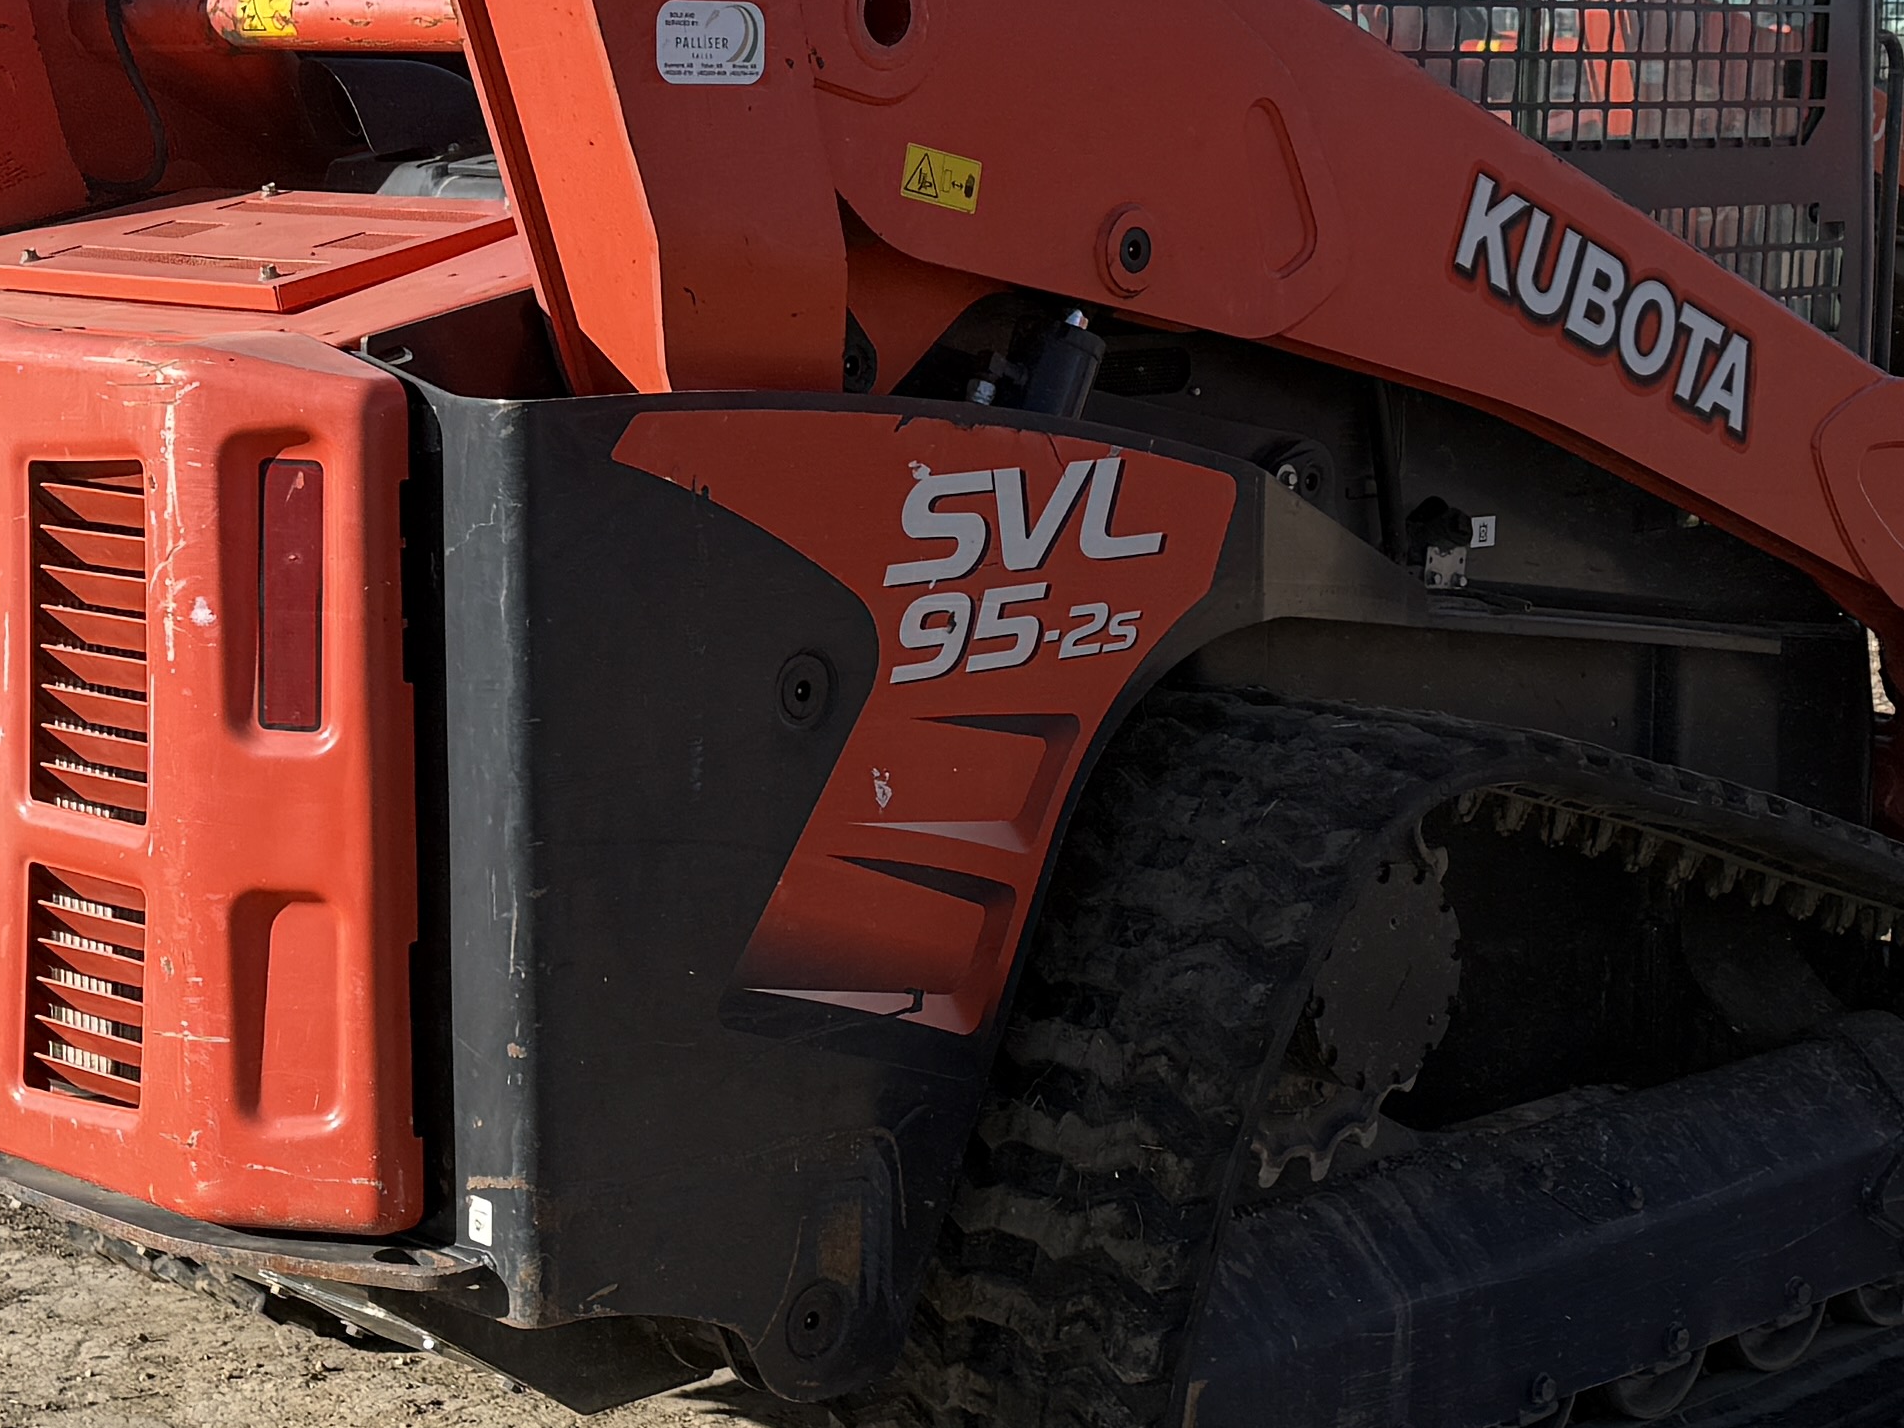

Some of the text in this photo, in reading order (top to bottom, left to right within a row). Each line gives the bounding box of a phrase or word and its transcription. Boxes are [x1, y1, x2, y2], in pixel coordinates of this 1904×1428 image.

[675, 35, 729, 50] PALLISER
[1454, 172, 1750, 434] KUBOTA
[883, 457, 1165, 587] SVL
